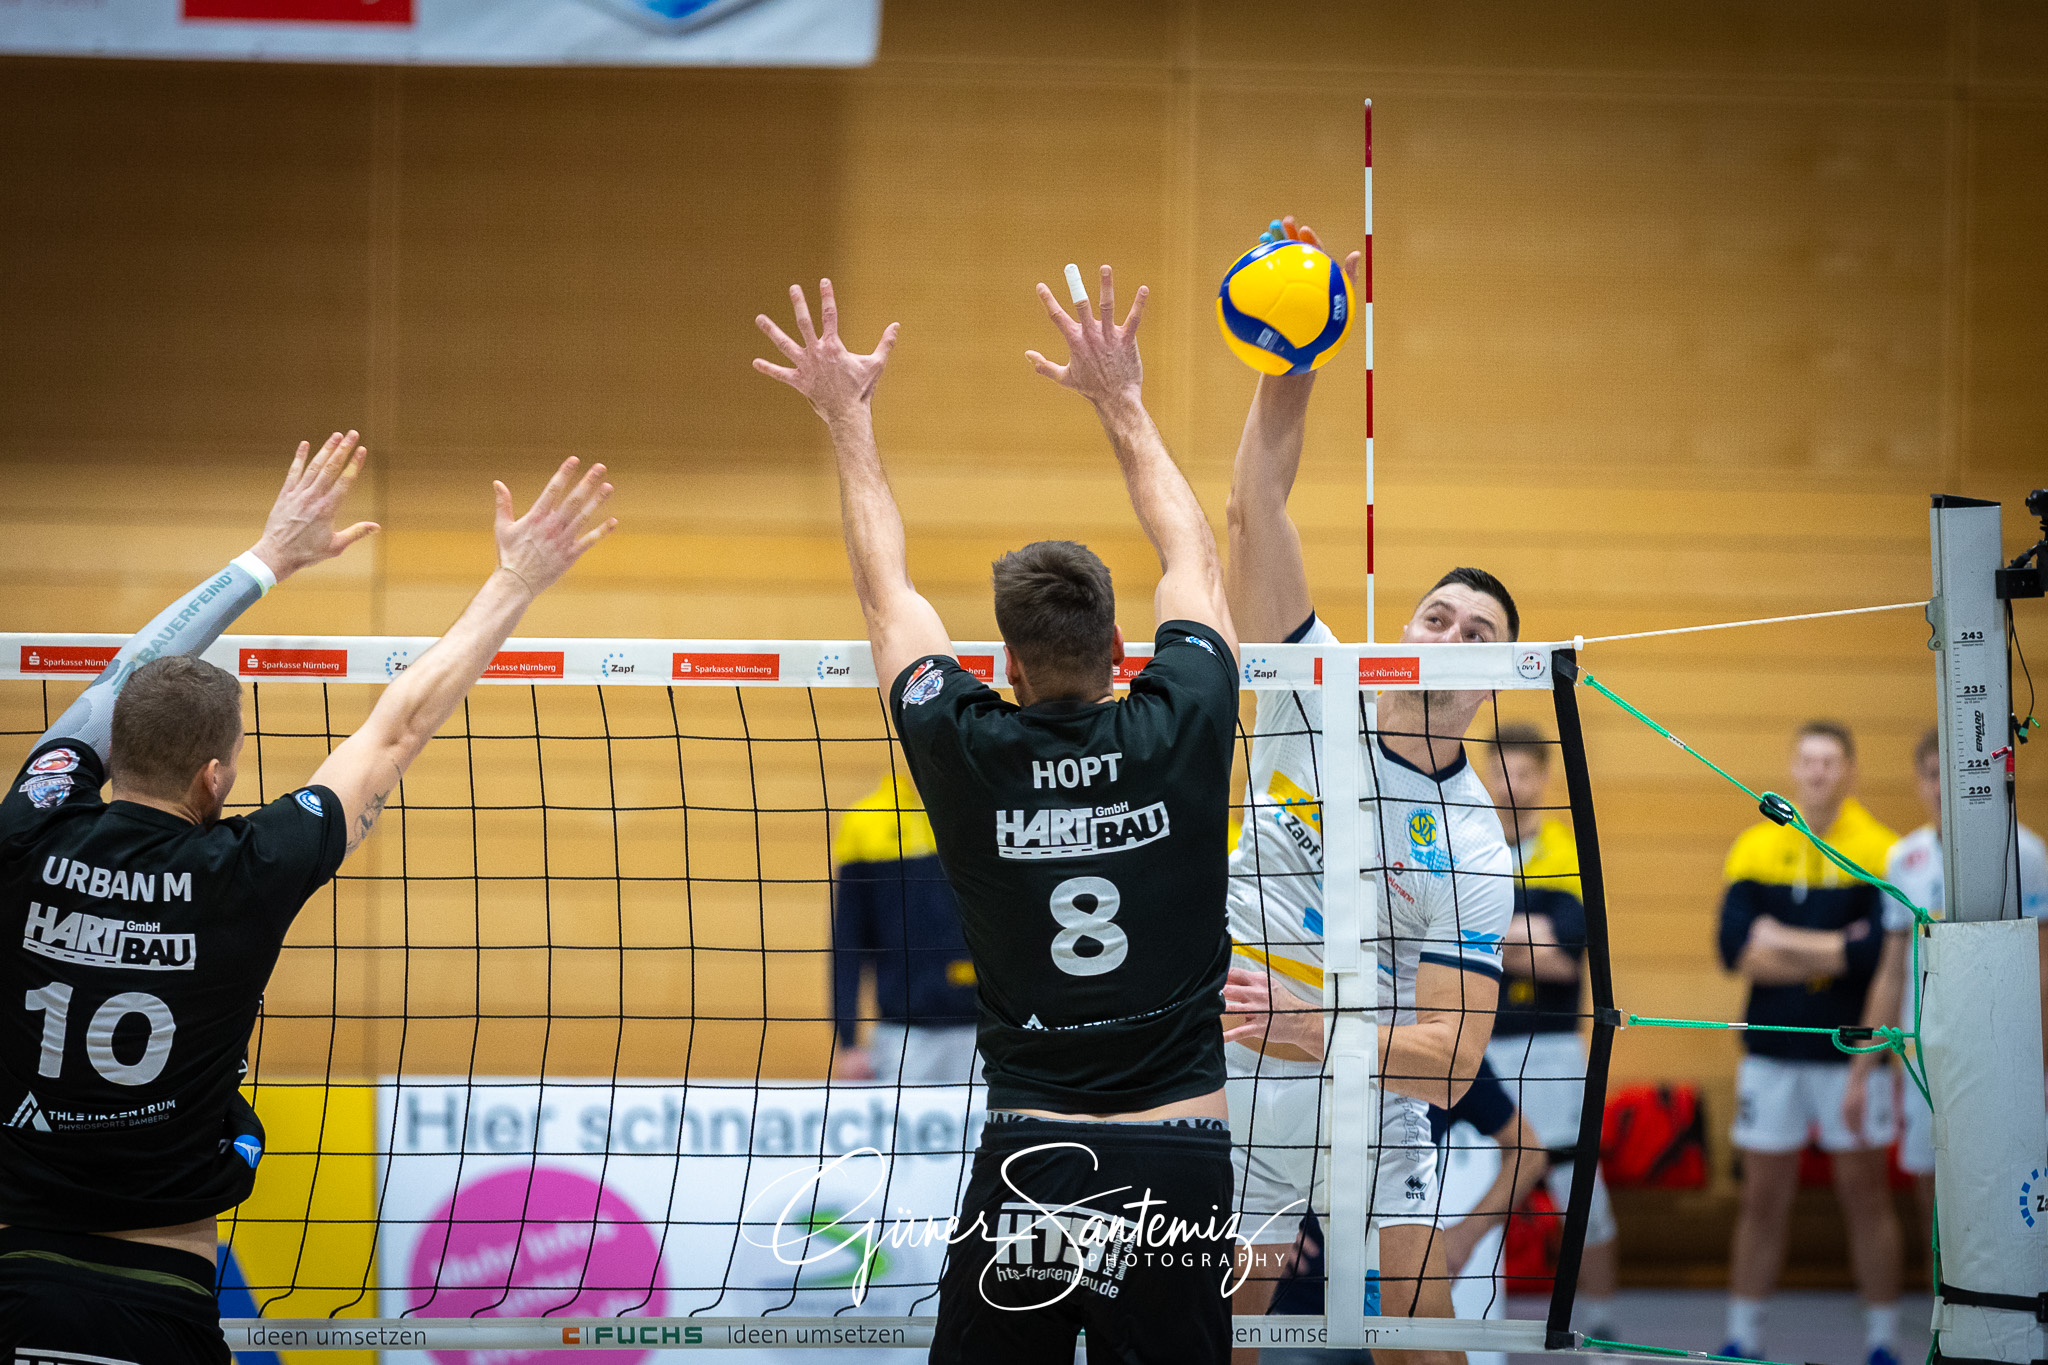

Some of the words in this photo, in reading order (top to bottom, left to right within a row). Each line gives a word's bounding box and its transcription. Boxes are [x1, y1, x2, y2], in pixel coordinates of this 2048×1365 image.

[1961, 631, 1984, 640] 243
[43, 658, 83, 668] Sparkasse
[84, 657, 111, 667] Nürnb
[262, 660, 301, 669] Sparkasse
[302, 661, 340, 671] Nürnberg
[394, 662, 408, 671] Za
[484, 663, 519, 672] parkasse
[519, 663, 556, 672] Nürnberg
[611, 664, 635, 674] Zapf
[695, 665, 734, 675] Sparkasse
[735, 665, 772, 675] Nürnberg
[826, 666, 850, 676] Zapf
[1253, 668, 1278, 679] Zapf
[1376, 669, 1412, 678] Nürnberg
[1964, 684, 1986, 694] 235
[1975, 710, 1983, 753] ERHARD
[1032, 752, 1123, 789] HOPT
[1967, 759, 1990, 768] 224
[1968, 785, 1991, 795] 220
[1095, 801, 1129, 817] GmbH
[996, 807, 1093, 847] HART
[1095, 806, 1166, 849] BAU
[1285, 815, 1321, 857] Zapf
[41, 855, 155, 903] URBAN
[162, 872, 192, 902] M
[24, 901, 125, 955] HART
[126, 920, 161, 933] GmbH
[1050, 876, 1129, 977] 8
[121, 934, 193, 967] BAU
[25, 981, 176, 1086] 10
[58, 1120, 126, 1131] PHYSIOSPORTS
[128, 1113, 170, 1127] BAMBERG
[404, 1092, 556, 1155] Hier
[996, 1213, 1109, 1273] HTS
[247, 1326, 308, 1346] Ideen
[316, 1326, 427, 1346] umsetzen
[595, 1326, 703, 1345] FUCHS
[727, 1324, 788, 1344] Ideen
[796, 1324, 905, 1344] umsetzen
